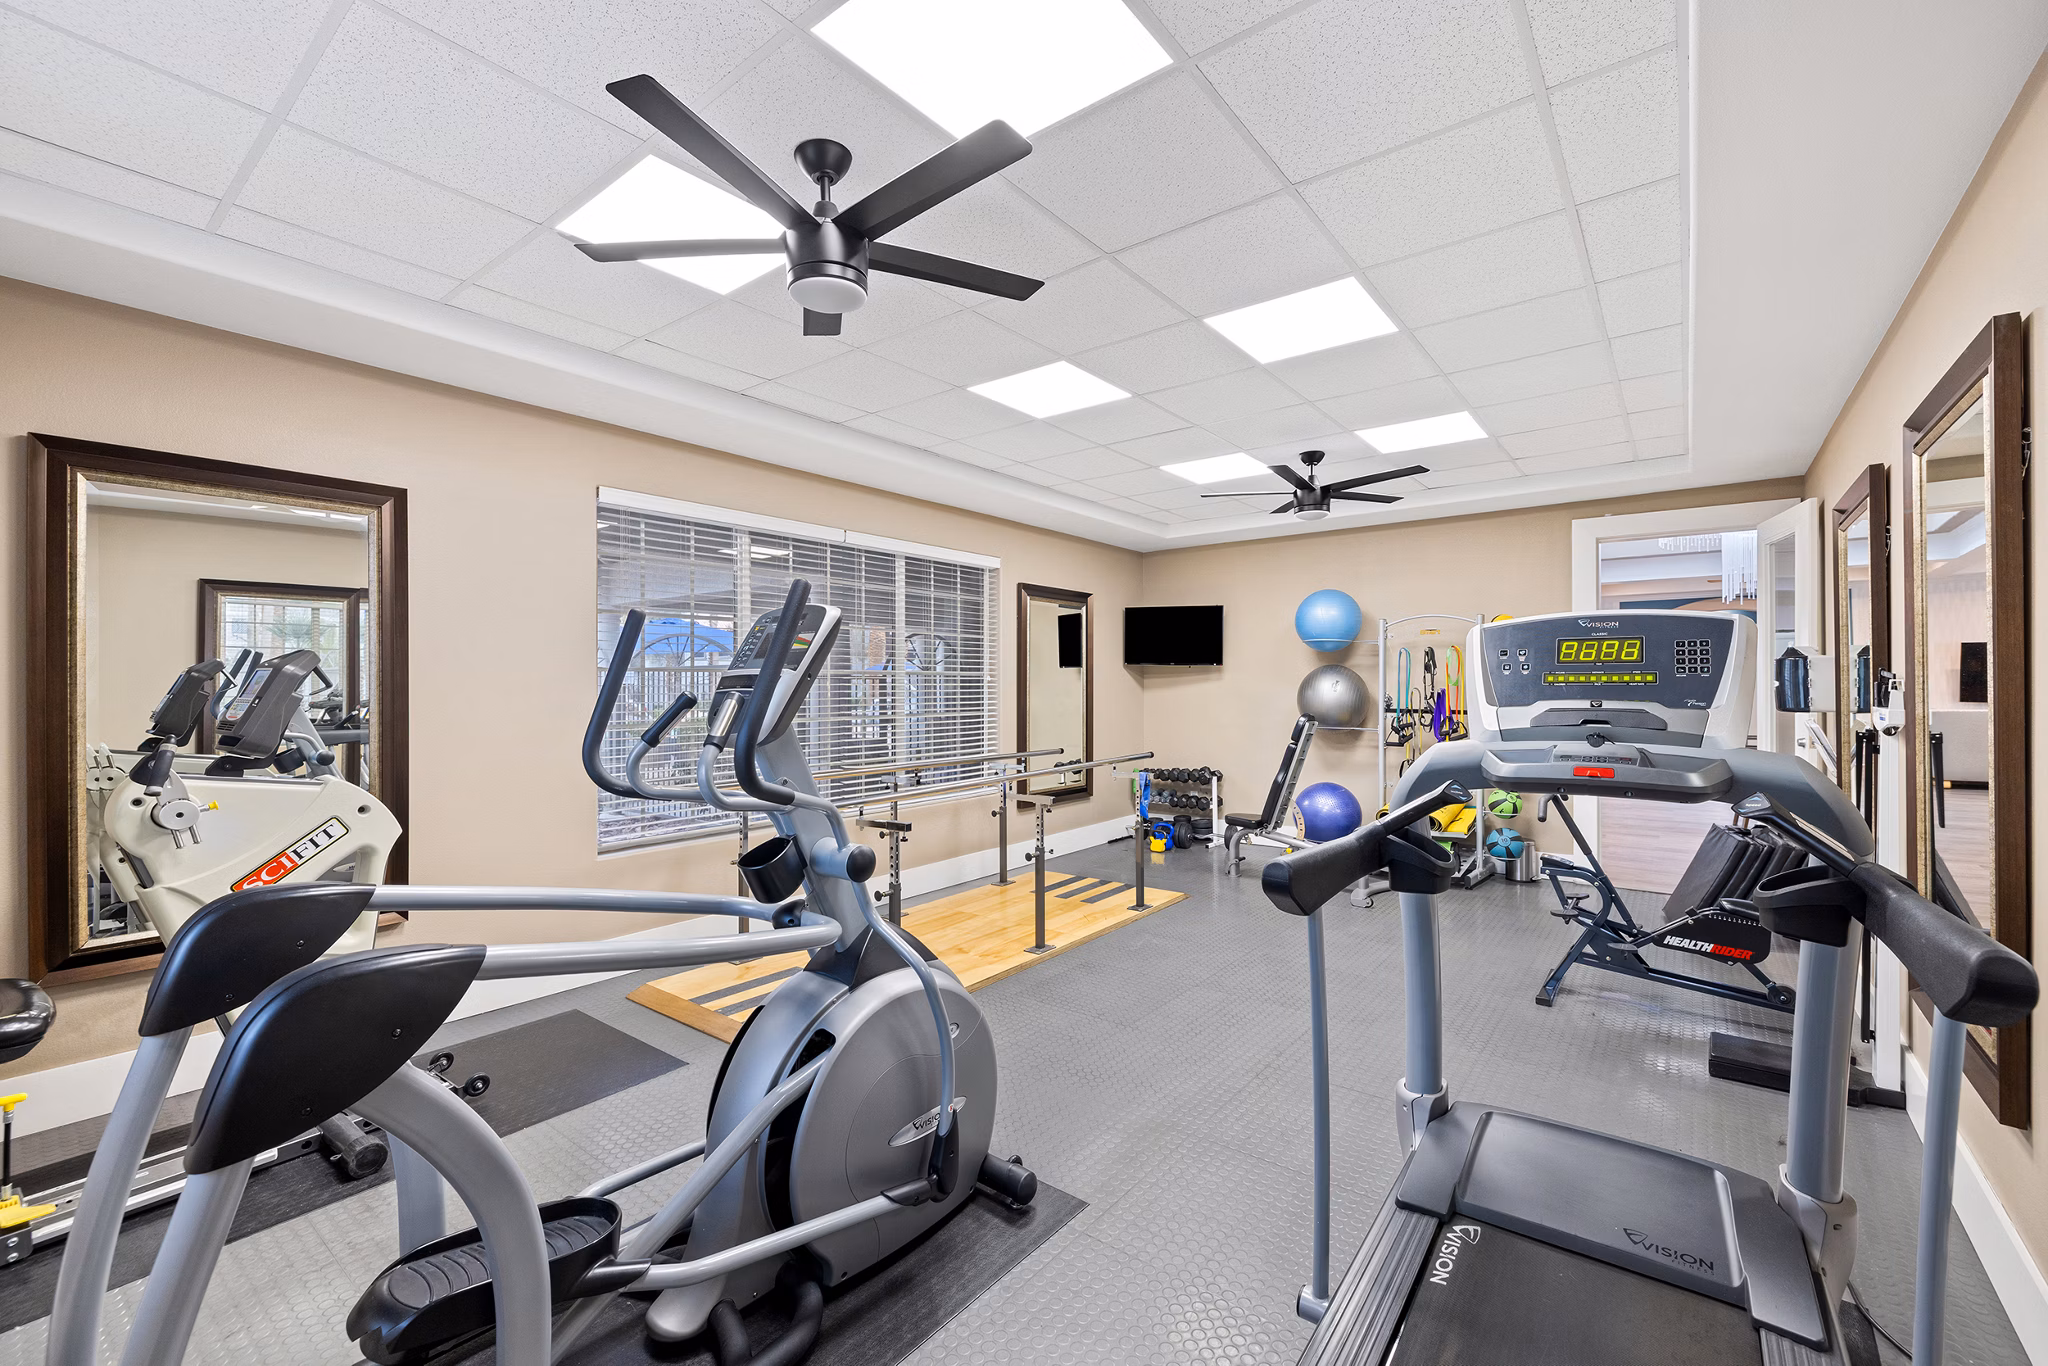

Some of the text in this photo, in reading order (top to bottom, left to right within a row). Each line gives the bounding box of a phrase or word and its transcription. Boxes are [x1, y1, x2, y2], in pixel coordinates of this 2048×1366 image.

[1560, 641, 1640, 661] 8888
[242, 823, 336, 889] SCIFIT
[1663, 935, 1754, 960] HEALTHRIDER
[919, 1112, 941, 1129] VISIO
[1429, 1231, 1462, 1286] VISION
[1641, 1241, 1714, 1271] VISION
[1671, 1259, 1715, 1276] FITNESS
